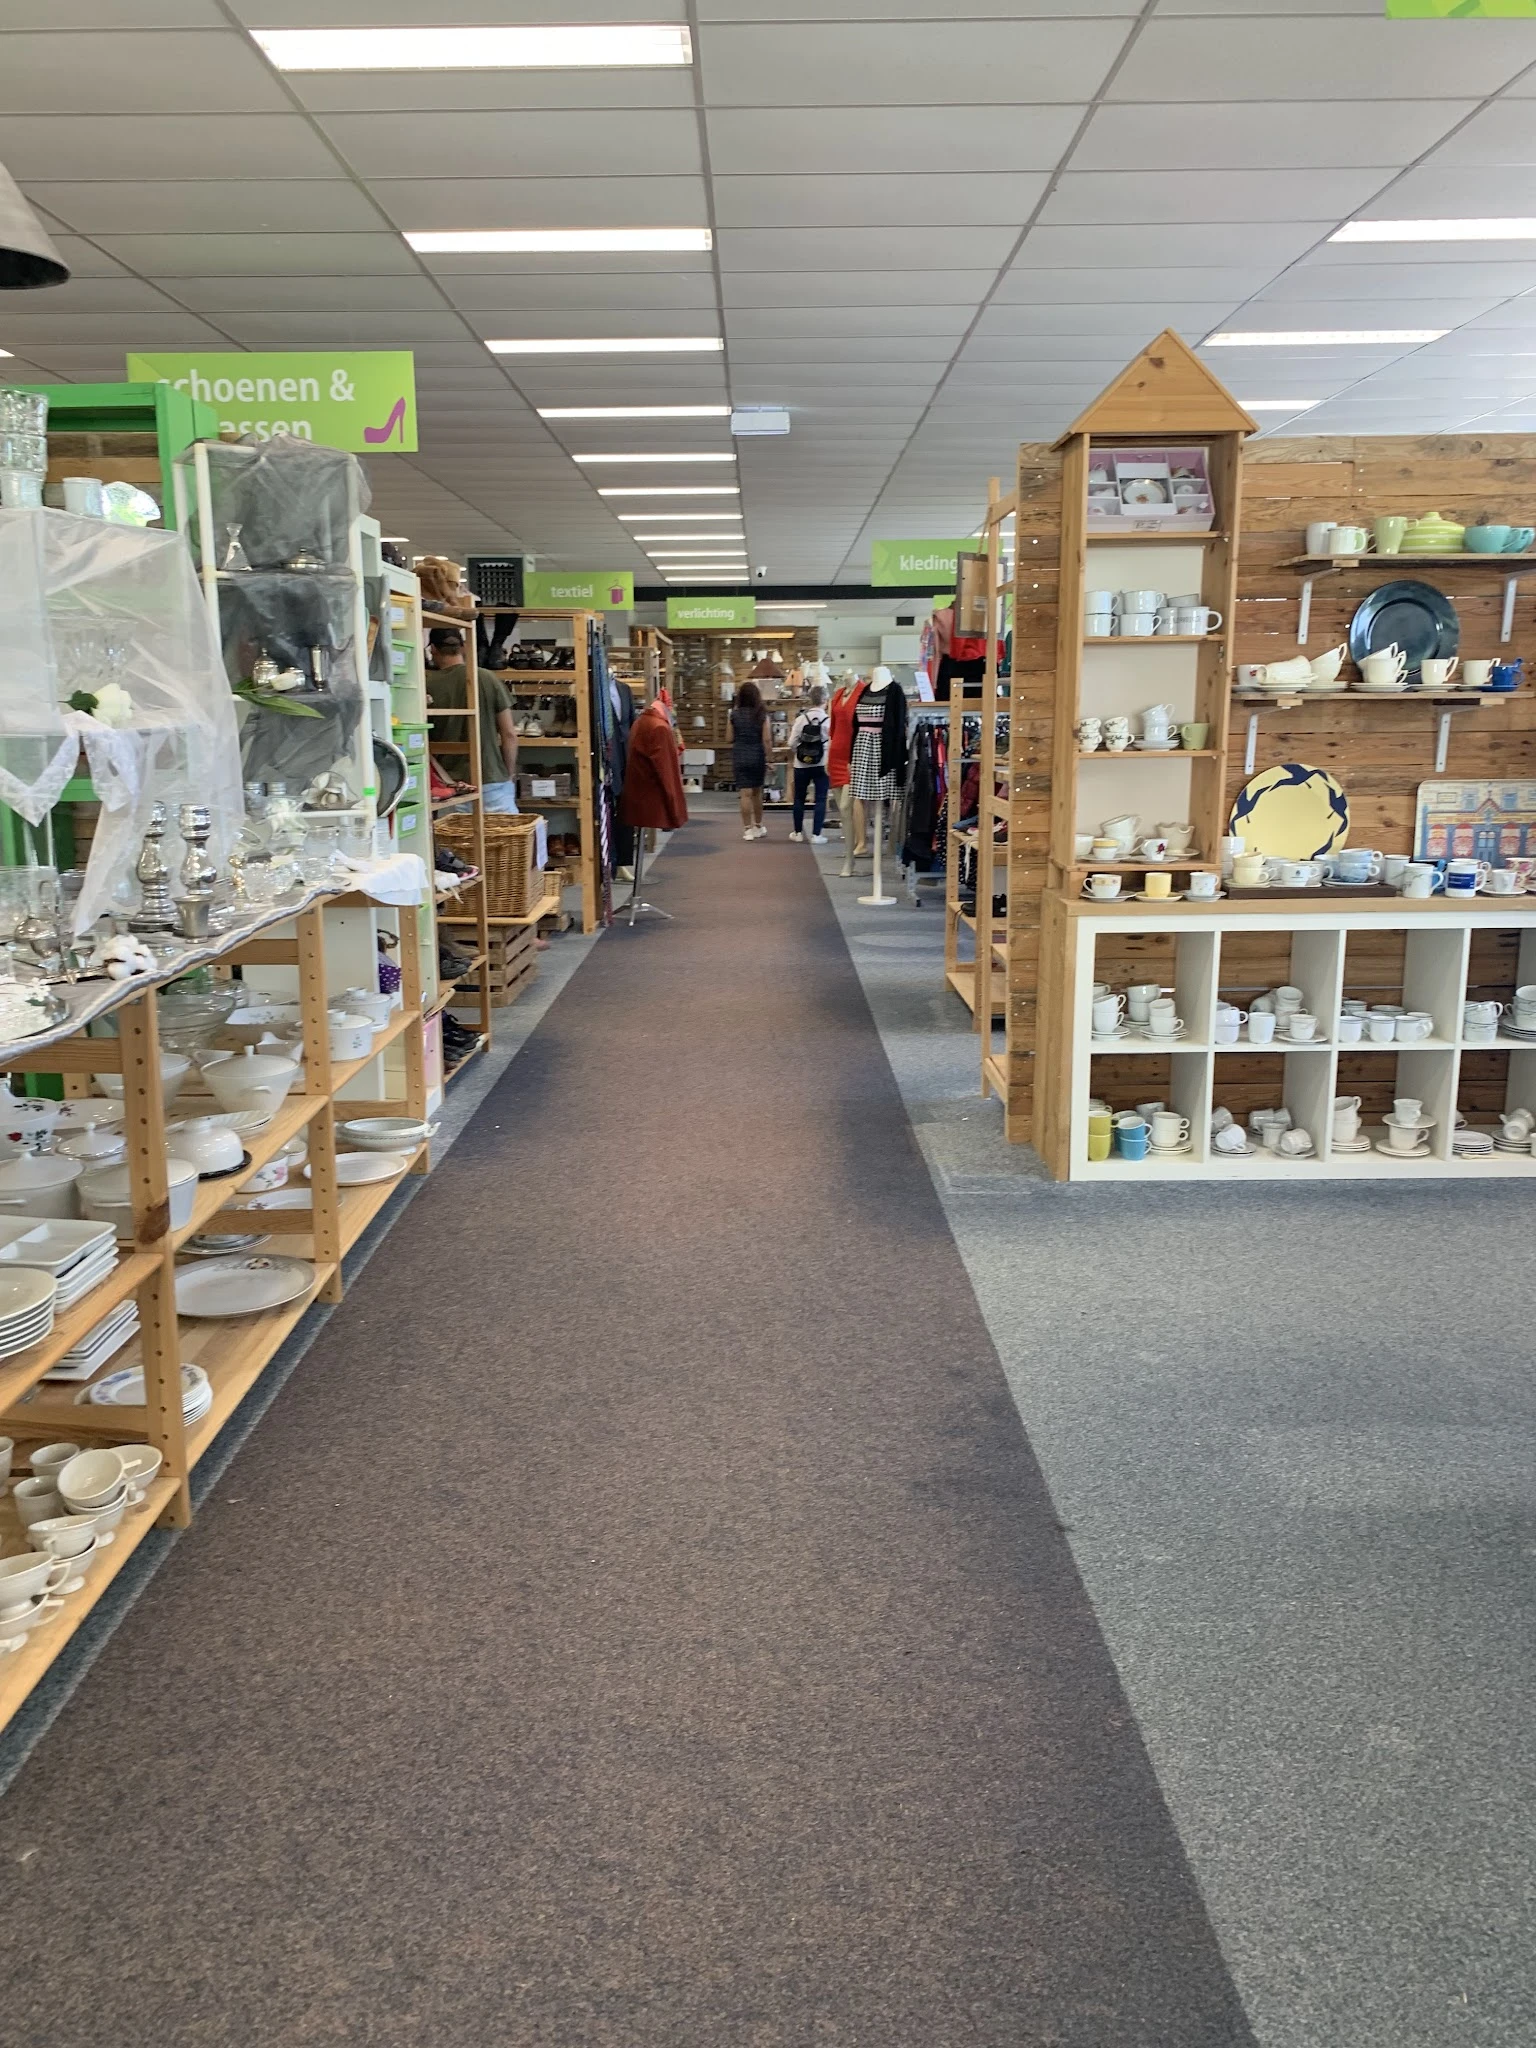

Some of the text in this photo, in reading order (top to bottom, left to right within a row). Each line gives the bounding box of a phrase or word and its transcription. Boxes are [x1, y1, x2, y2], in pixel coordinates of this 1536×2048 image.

[158, 369, 356, 402] hoenen &
[219, 420, 312, 443] assen
[900, 555, 958, 574] kleding
[551, 585, 592, 598] textiel
[678, 608, 735, 620] verlichting
